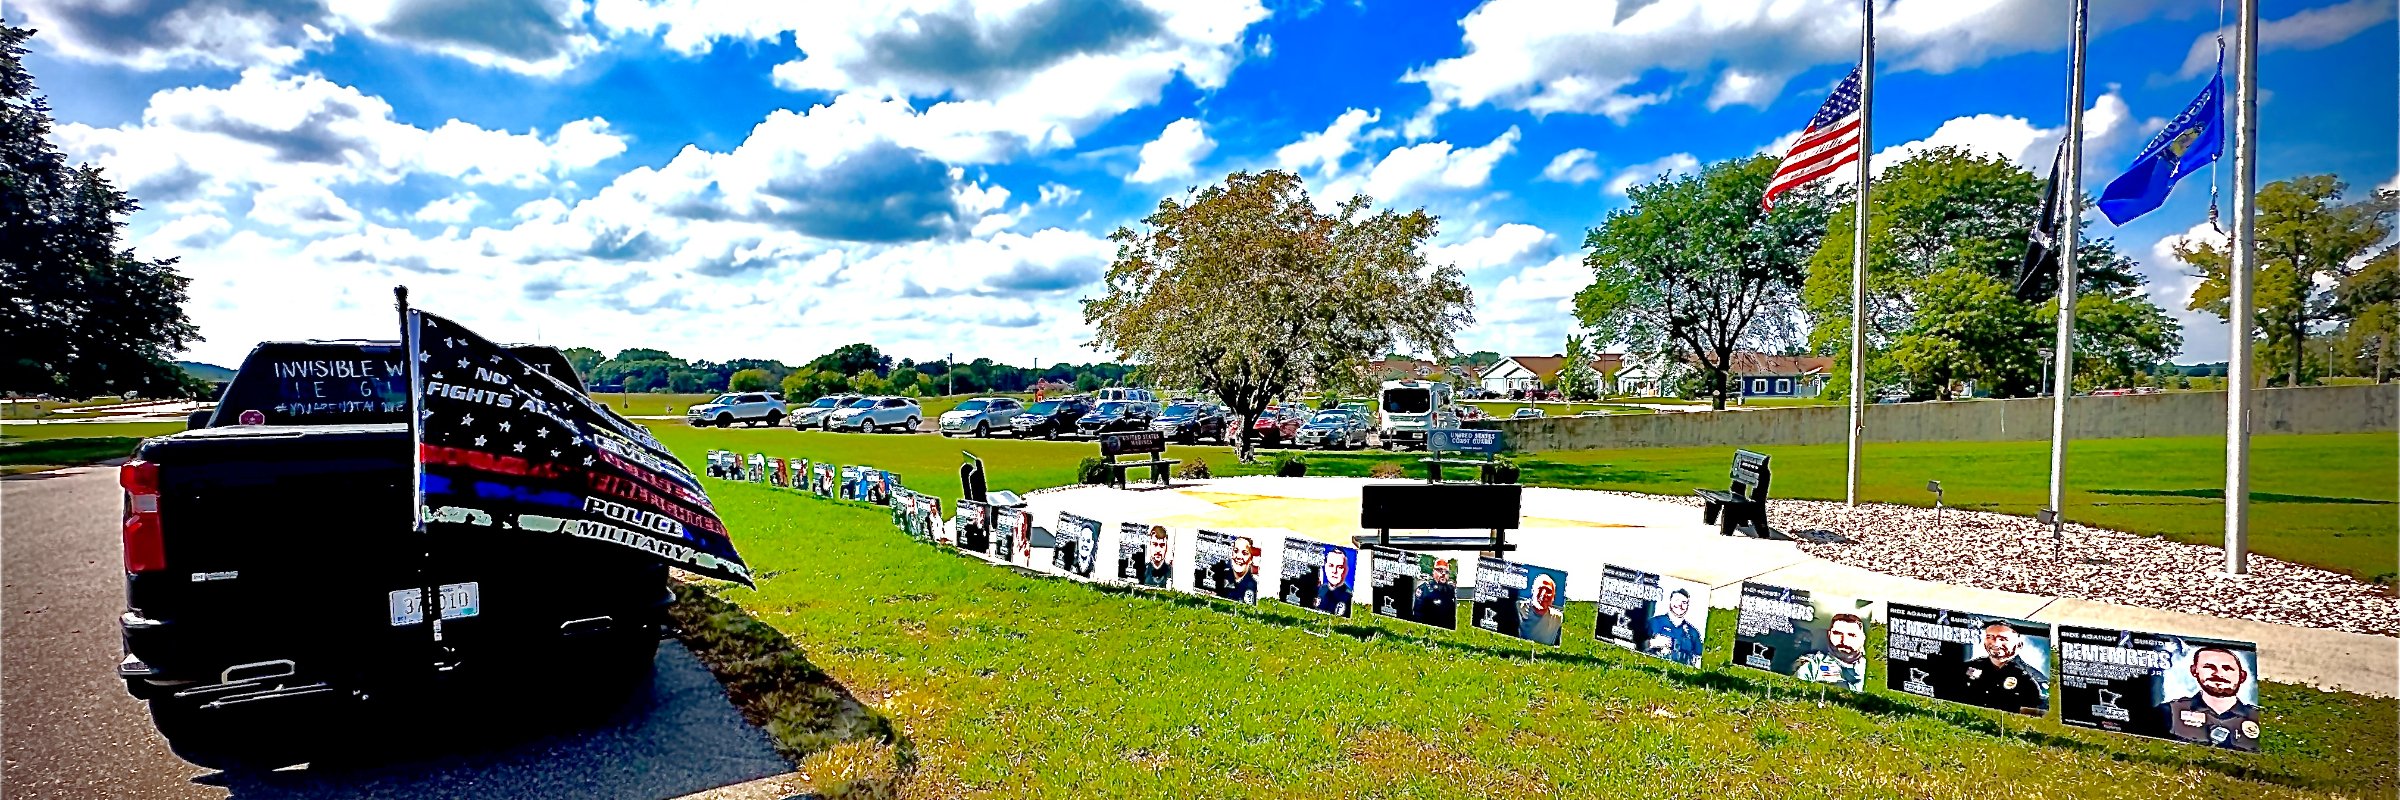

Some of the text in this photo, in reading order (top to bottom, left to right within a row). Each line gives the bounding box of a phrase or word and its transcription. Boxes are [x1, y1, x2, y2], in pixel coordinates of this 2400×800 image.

[274, 360, 375, 378] INVISIBLE
[474, 366, 512, 385] NO
[426, 381, 513, 408] FIGHTS
[1450, 432, 1495, 440] UNITED STATES
[583, 495, 685, 538] POLICE
[588, 470, 727, 538] FIREFIGHTER
[577, 518, 695, 563] MILITARY
[1906, 610, 1937, 619] AGAINST
[1889, 616, 1981, 645] REMEMBERS
[2081, 633, 2118, 642] AGAINST
[2061, 641, 2171, 671] REMEMBERS
